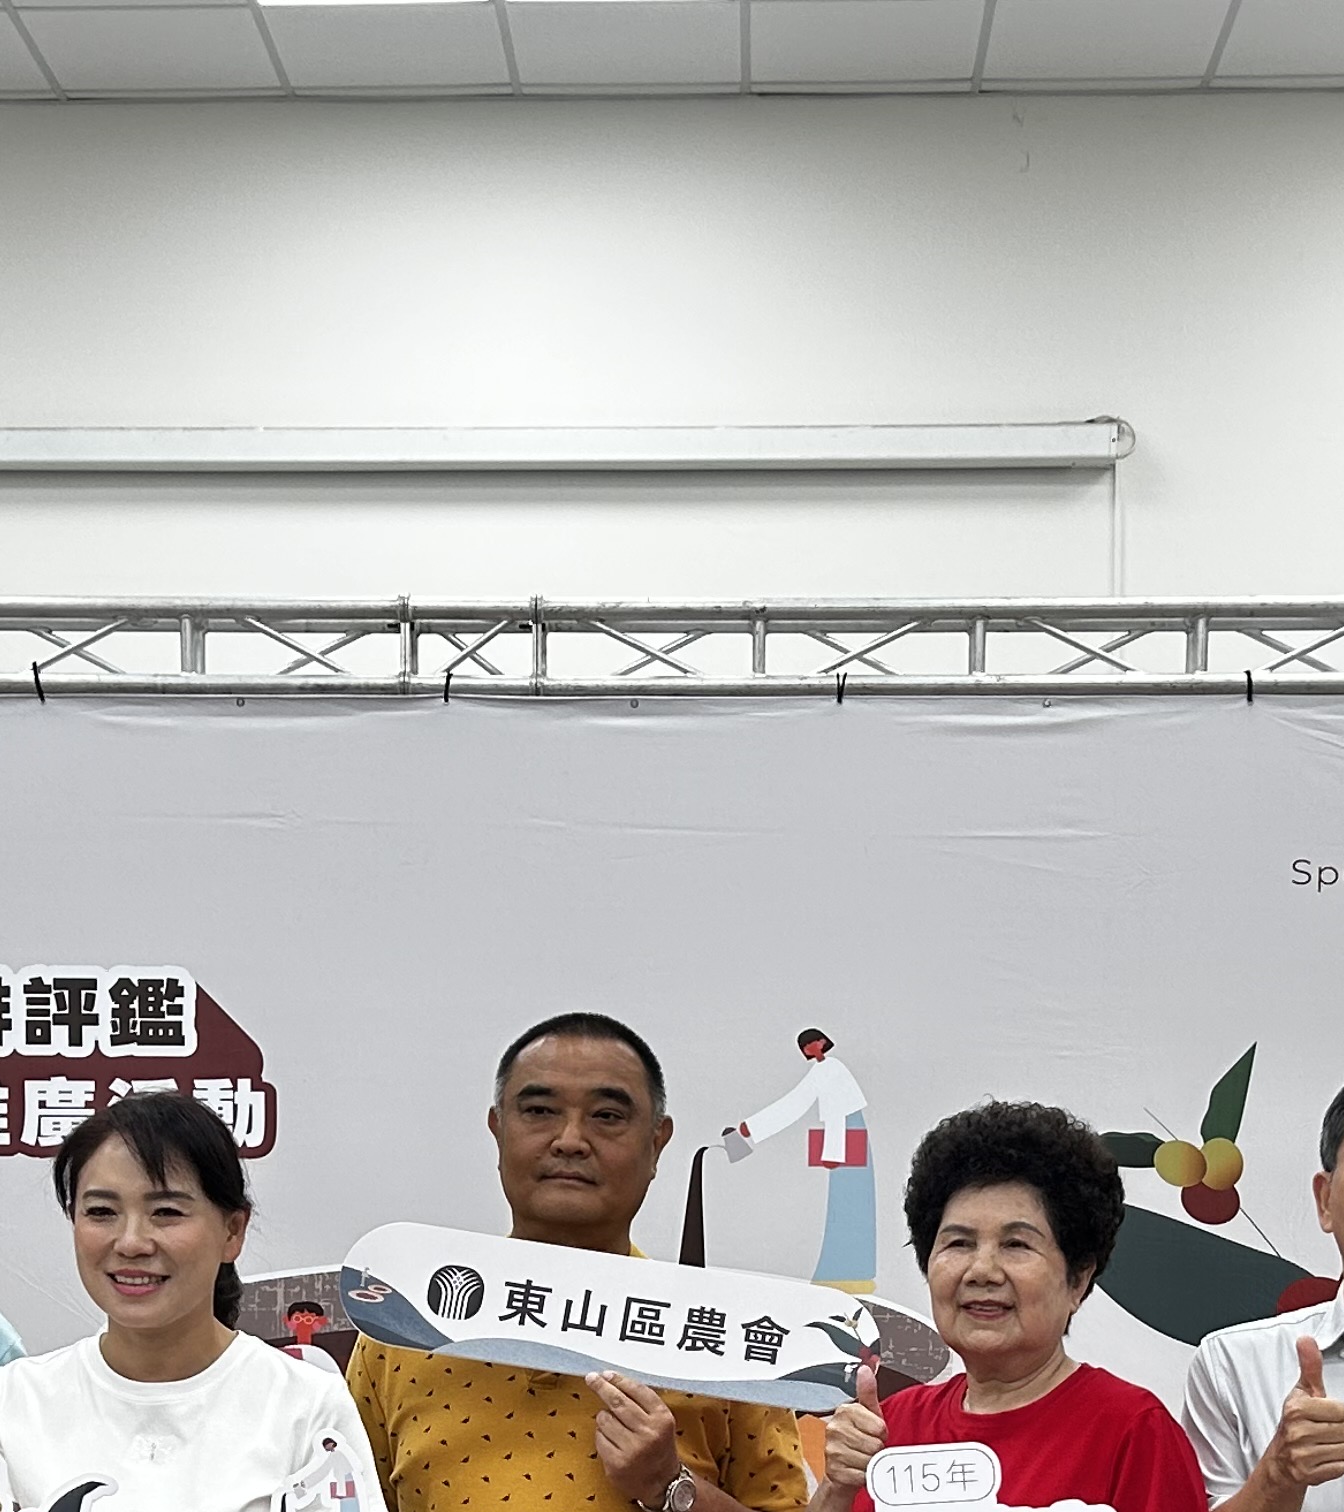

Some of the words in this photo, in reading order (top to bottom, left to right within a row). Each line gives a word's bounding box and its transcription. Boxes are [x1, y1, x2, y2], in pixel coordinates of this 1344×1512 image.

[498, 1277, 793, 1366] 東山區農會
[884, 1458, 981, 1495] 115年
